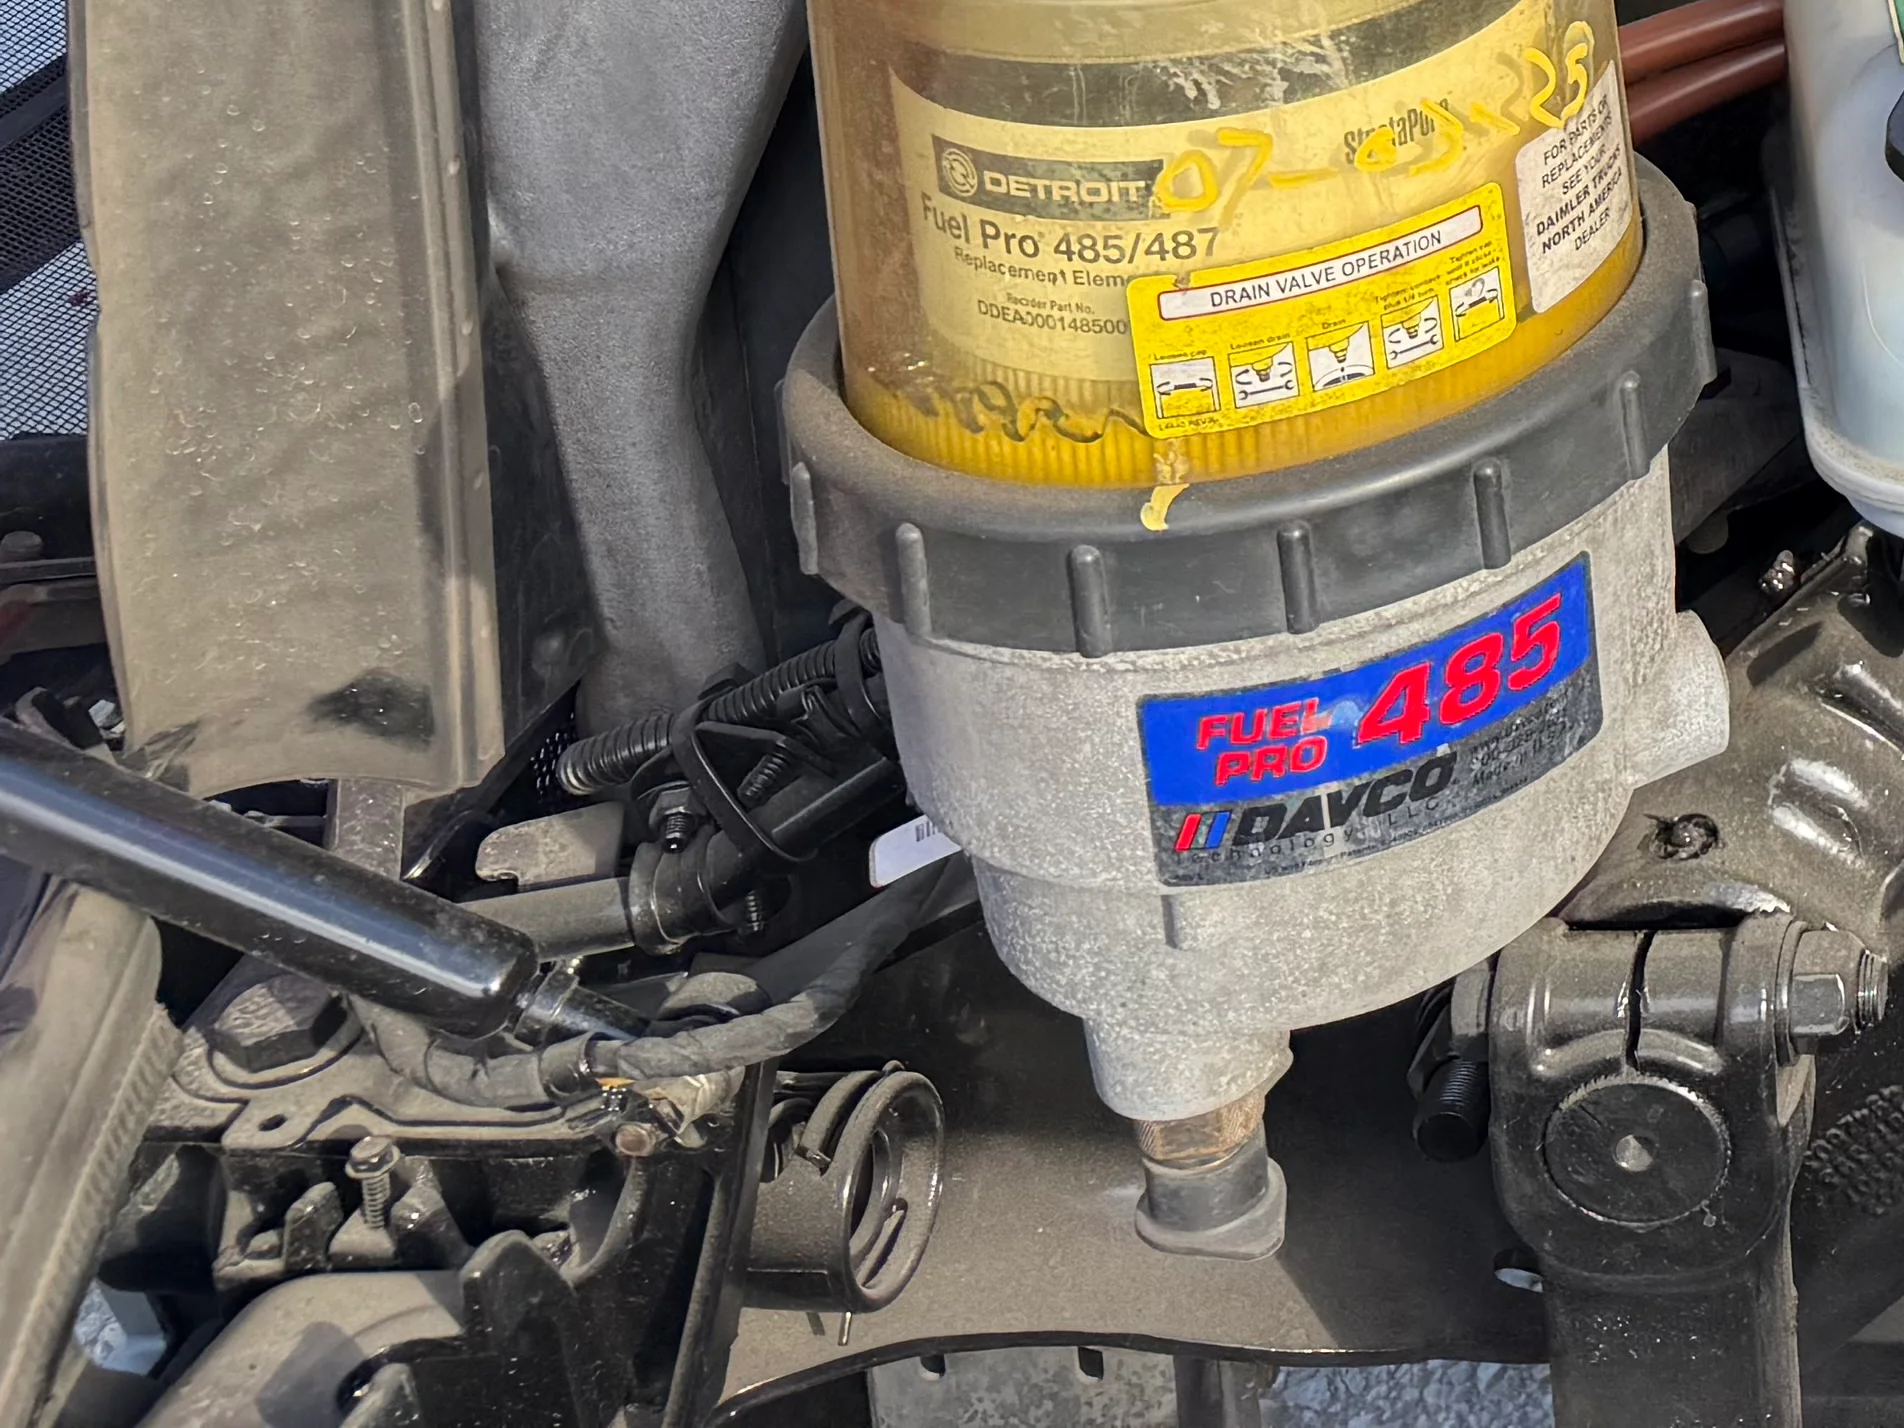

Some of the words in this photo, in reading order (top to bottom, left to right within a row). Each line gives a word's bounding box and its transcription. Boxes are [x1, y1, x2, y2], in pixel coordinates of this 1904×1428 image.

[1543, 138, 1567, 166] FOR
[983, 169, 1146, 203] DETROIT
[1536, 183, 1591, 236] DAIMLER
[1562, 173, 1585, 195] SEE
[920, 190, 971, 243] Fuel
[980, 218, 1041, 259] Pro
[1053, 226, 1219, 265] 485/487
[1541, 211, 1585, 254] NORTH
[1587, 171, 1623, 215] AMERICA
[1575, 207, 1611, 251] DEALER
[953, 246, 1068, 286] Replacement
[1210, 270, 1272, 310] DRAIN
[1275, 262, 1337, 295] VALVE
[1341, 227, 1444, 278] OPERATION
[1049, 298, 1073, 314] Part
[1076, 303, 1096, 315] No.
[1356, 591, 1563, 749] 485
[1195, 696, 1334, 751] FUEL
[1215, 735, 1329, 788] PRO
[1230, 751, 1459, 844] DAVCO
